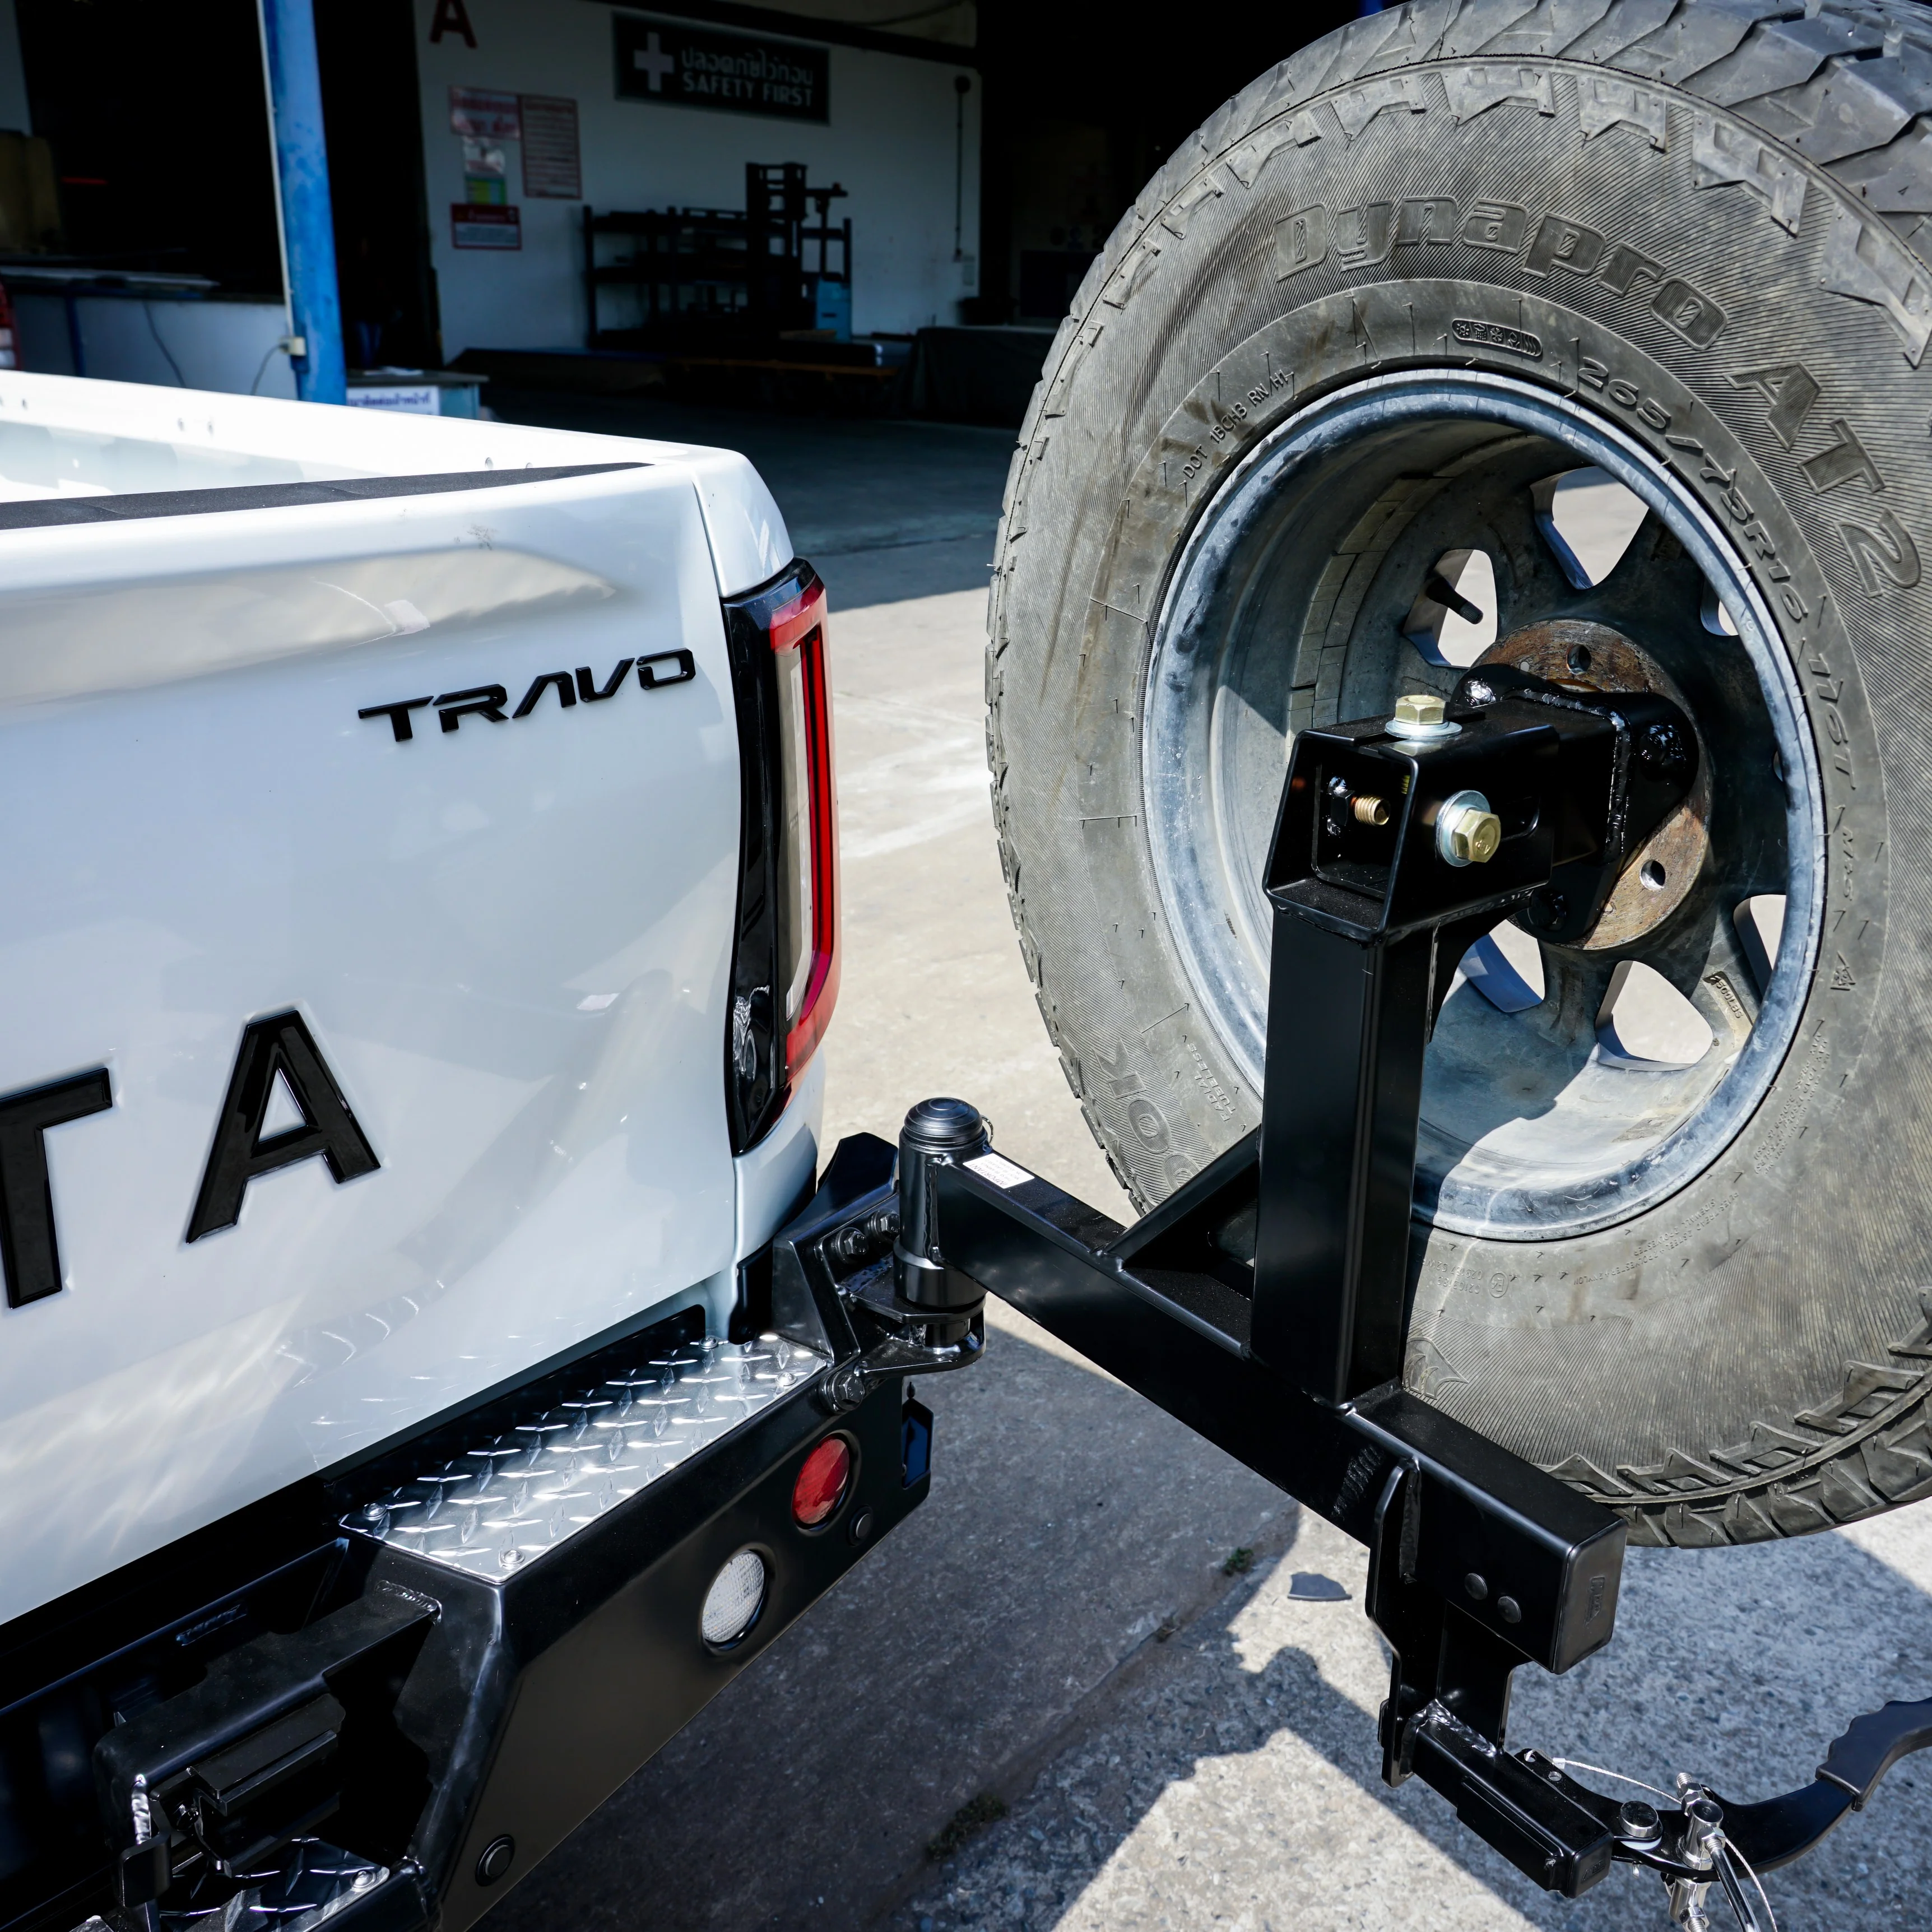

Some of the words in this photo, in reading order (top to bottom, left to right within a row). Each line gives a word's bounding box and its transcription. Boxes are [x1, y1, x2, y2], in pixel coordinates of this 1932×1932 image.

[430, 0, 477, 48] A
[682, 71, 756, 100] SAFETY
[762, 82, 813, 107] FIRST
[1275, 194, 1728, 351] Dynapro
[1182, 444, 1208, 479] DOT
[1210, 402, 1247, 444] 1BCH3
[1247, 383, 1270, 405] RN
[1578, 356, 1809, 620] 265/75R16
[1808, 653, 1856, 791] 116T
[357, 647, 696, 742] TRAVO
[1186, 1042, 1236, 1115] TUBELESS
[1193, 1074, 1231, 1122] RADIAL
[969, 1163, 1007, 1186] IMPORTANT
[1680, 1197, 1717, 1229] SIDEWALL
[1632, 1226, 1680, 1257] 2POLYESTER
